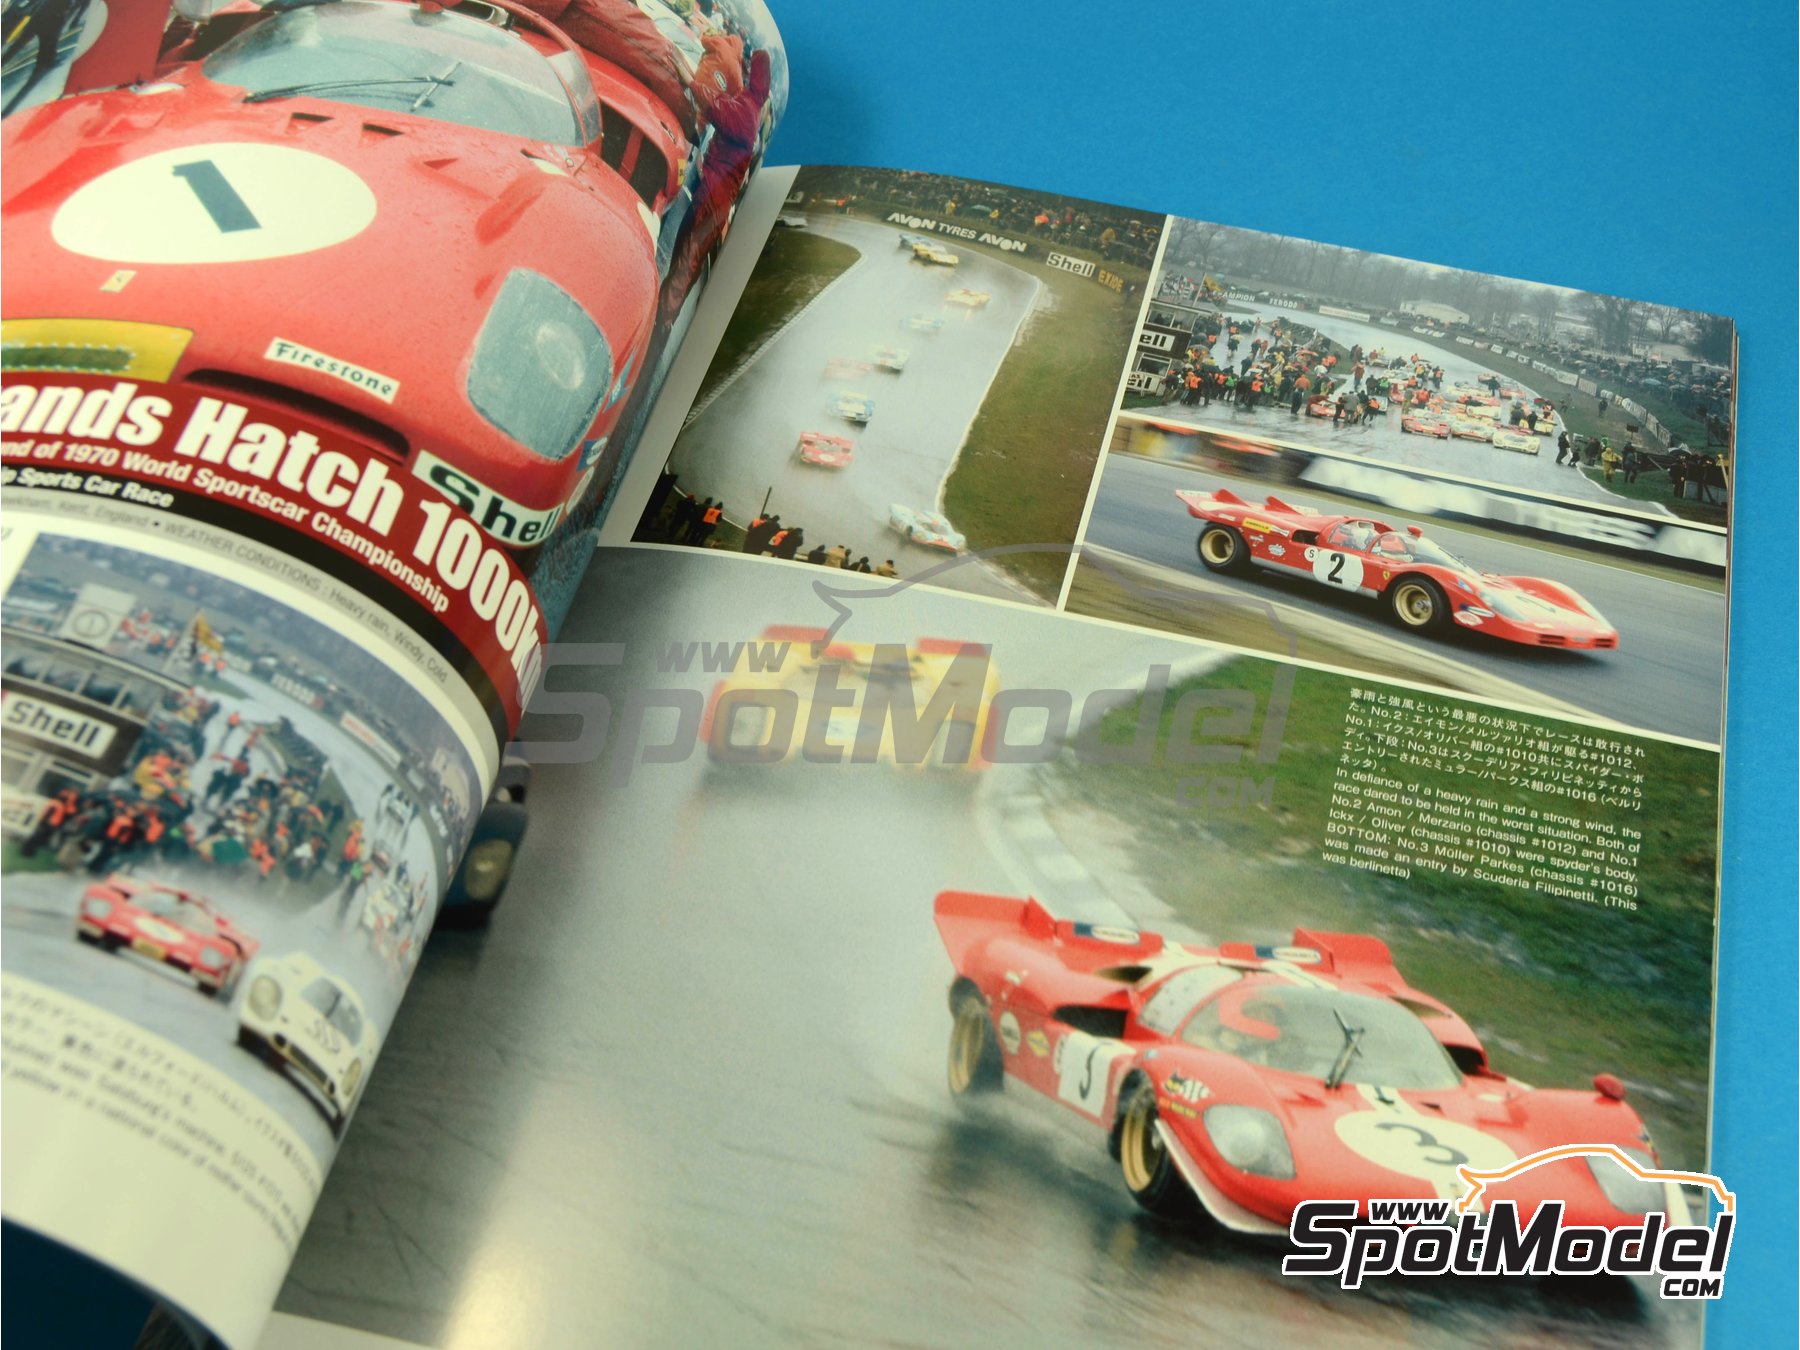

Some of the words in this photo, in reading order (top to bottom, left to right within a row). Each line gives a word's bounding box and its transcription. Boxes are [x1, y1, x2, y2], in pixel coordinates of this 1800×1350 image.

[172, 159, 262, 233] 1
[887, 212, 936, 229] AVON
[938, 222, 977, 239] TYRES
[978, 232, 1027, 252] AVON
[1048, 253, 1093, 277] Shell
[1098, 269, 1125, 293] EXIDE
[276, 341, 392, 396] Firestone
[17, 467, 83, 489] Sports
[83, 475, 122, 496] Car
[121, 481, 174, 508] Race
[173, 397, 404, 537] Hatch
[32, 441, 64, 460] of
[64, 443, 119, 467] 1970
[122, 451, 193, 483] World
[193, 468, 310, 523] Sportscar
[311, 511, 449, 613] Championship
[429, 464, 561, 543] Shell
[165, 522, 233, 551] WEATHER
[1308, 549, 1315, 559] S
[1328, 552, 1345, 584] 2
[8, 701, 100, 747] Shell
[1331, 793, 1361, 809] No.2
[1366, 801, 1401, 817] Amon
[1418, 812, 1471, 832] Merzario
[1476, 825, 1526, 844] (chassis
[1531, 837, 1576, 856] #1012)
[1581, 848, 1604, 860] and
[1610, 852, 1637, 866] No.1
[1333, 781, 1360, 794] race
[1363, 787, 1397, 802] dared
[1401, 794, 1412, 805] to
[1415, 797, 1431, 809] be
[1434, 801, 1460, 816] held
[1464, 807, 1474, 819] in
[1478, 811, 1497, 824] the
[1501, 817, 1533, 832] worst
[1537, 824, 1591, 843] situation.
[1596, 835, 1624, 850] Both
[1627, 843, 1640, 853] of
[1336, 766, 1347, 777] In
[1351, 770, 1402, 789] defiance
[1407, 782, 1419, 792] of
[1423, 786, 1431, 795] a
[1435, 787, 1471, 805] heavy
[1475, 798, 1498, 810] rain
[1502, 804, 1525, 815] and
[1529, 809, 1538, 818] a
[1542, 812, 1580, 828] strong
[1584, 820, 1616, 835] wind,
[1622, 826, 1641, 839] the
[1322, 851, 1345, 864] was
[1349, 855, 1410, 879] berlinetta)
[1326, 821, 1390, 844] BOTTOM:
[1397, 836, 1428, 852] No.3
[1434, 844, 1474, 862] Müller
[1480, 854, 1524, 873] Parkes
[1530, 865, 1583, 885] (chassis
[1589, 878, 1637, 897] #1016)
[1329, 807, 1354, 822] Ickx
[1371, 816, 1406, 832] Oliver
[1410, 825, 1460, 844] (chassis
[1465, 837, 1510, 857] #1010)
[1515, 849, 1545, 862] were
[1549, 856, 1600, 874] spyder's
[1605, 865, 1638, 882] body.
[1324, 837, 1348, 850] was
[1354, 844, 1388, 858] made
[1393, 852, 1410, 863] an
[1415, 857, 1447, 872] entry
[1452, 863, 1467, 877] by
[1473, 867, 1529, 889] Scuderia
[1535, 880, 1598, 903] Filipinetti.
[1603, 895, 1637, 910] (This
[1375, 1122, 1469, 1166] 3
